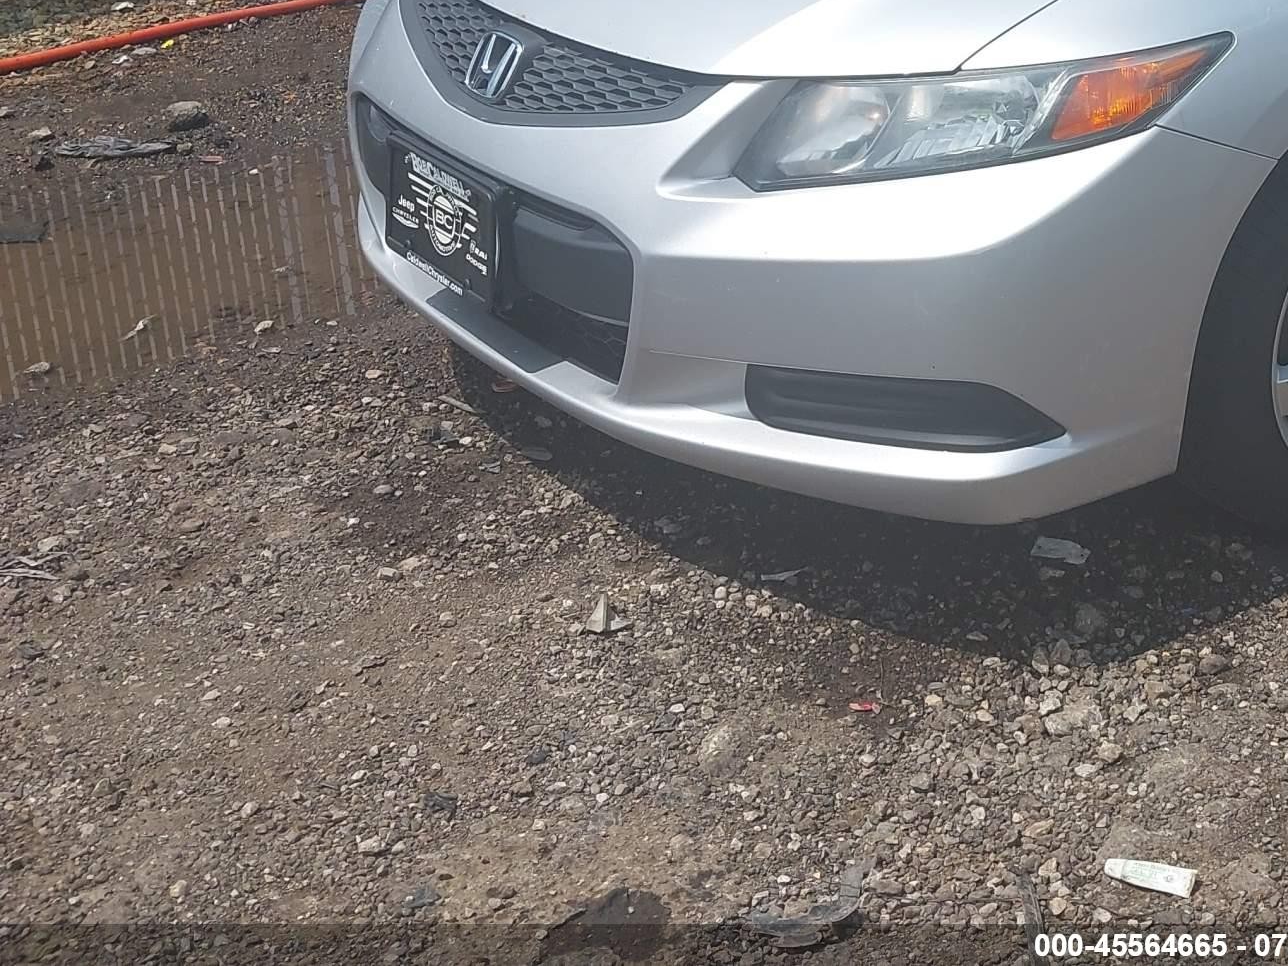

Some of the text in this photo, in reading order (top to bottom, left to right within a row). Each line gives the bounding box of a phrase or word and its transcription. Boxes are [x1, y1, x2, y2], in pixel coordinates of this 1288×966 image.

[397, 193, 415, 213] Jeep
[392, 206, 419, 224] CHRYSLER
[435, 208, 454, 231] BC
[406, 250, 463, 296] CaldwellChrysler.com
